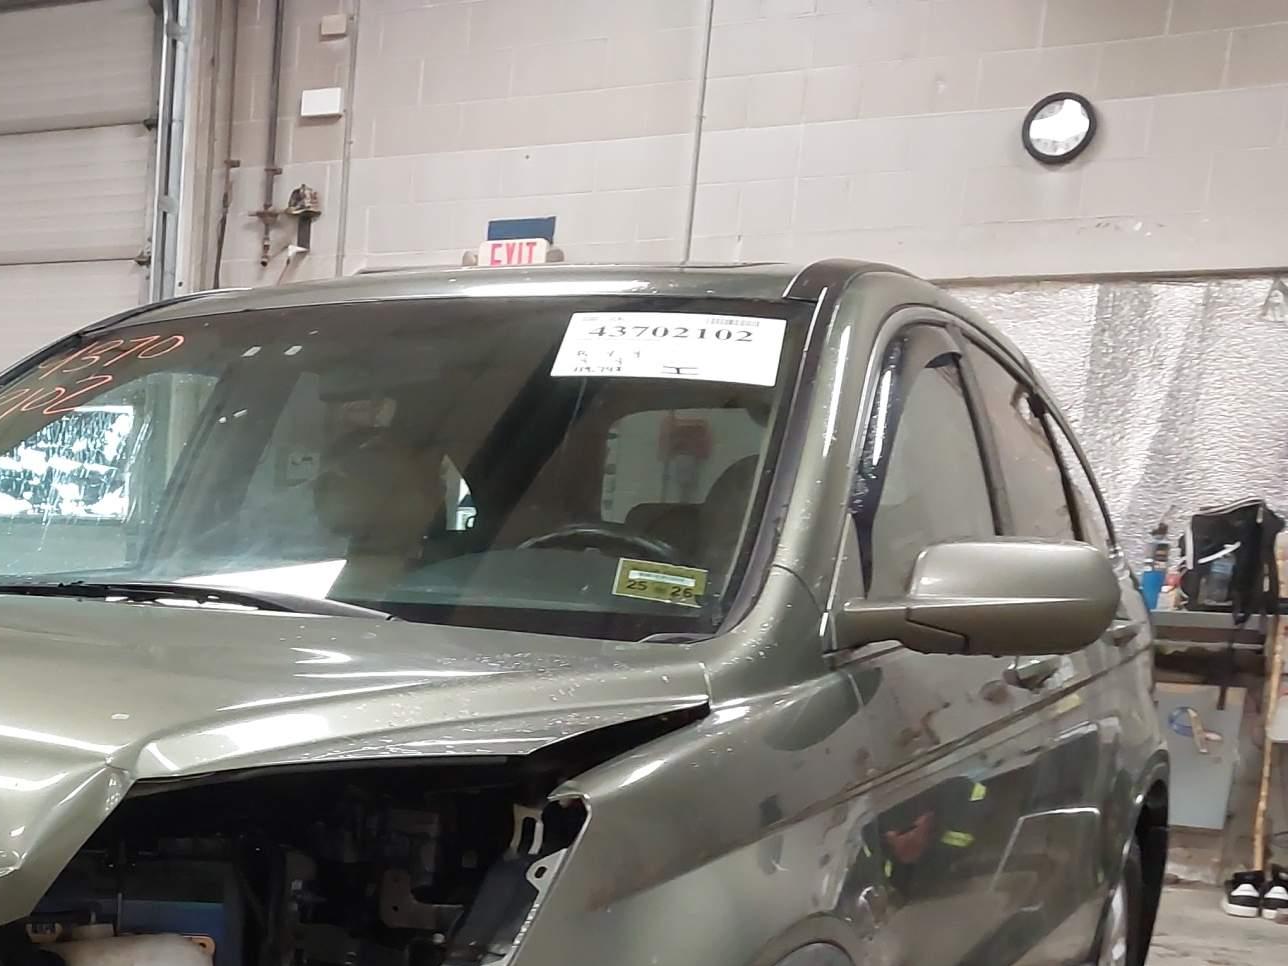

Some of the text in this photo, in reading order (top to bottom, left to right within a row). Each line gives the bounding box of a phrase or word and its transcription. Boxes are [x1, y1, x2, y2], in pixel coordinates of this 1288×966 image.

[588, 325, 753, 342] 43702102
[626, 580, 693, 598] 25 26
